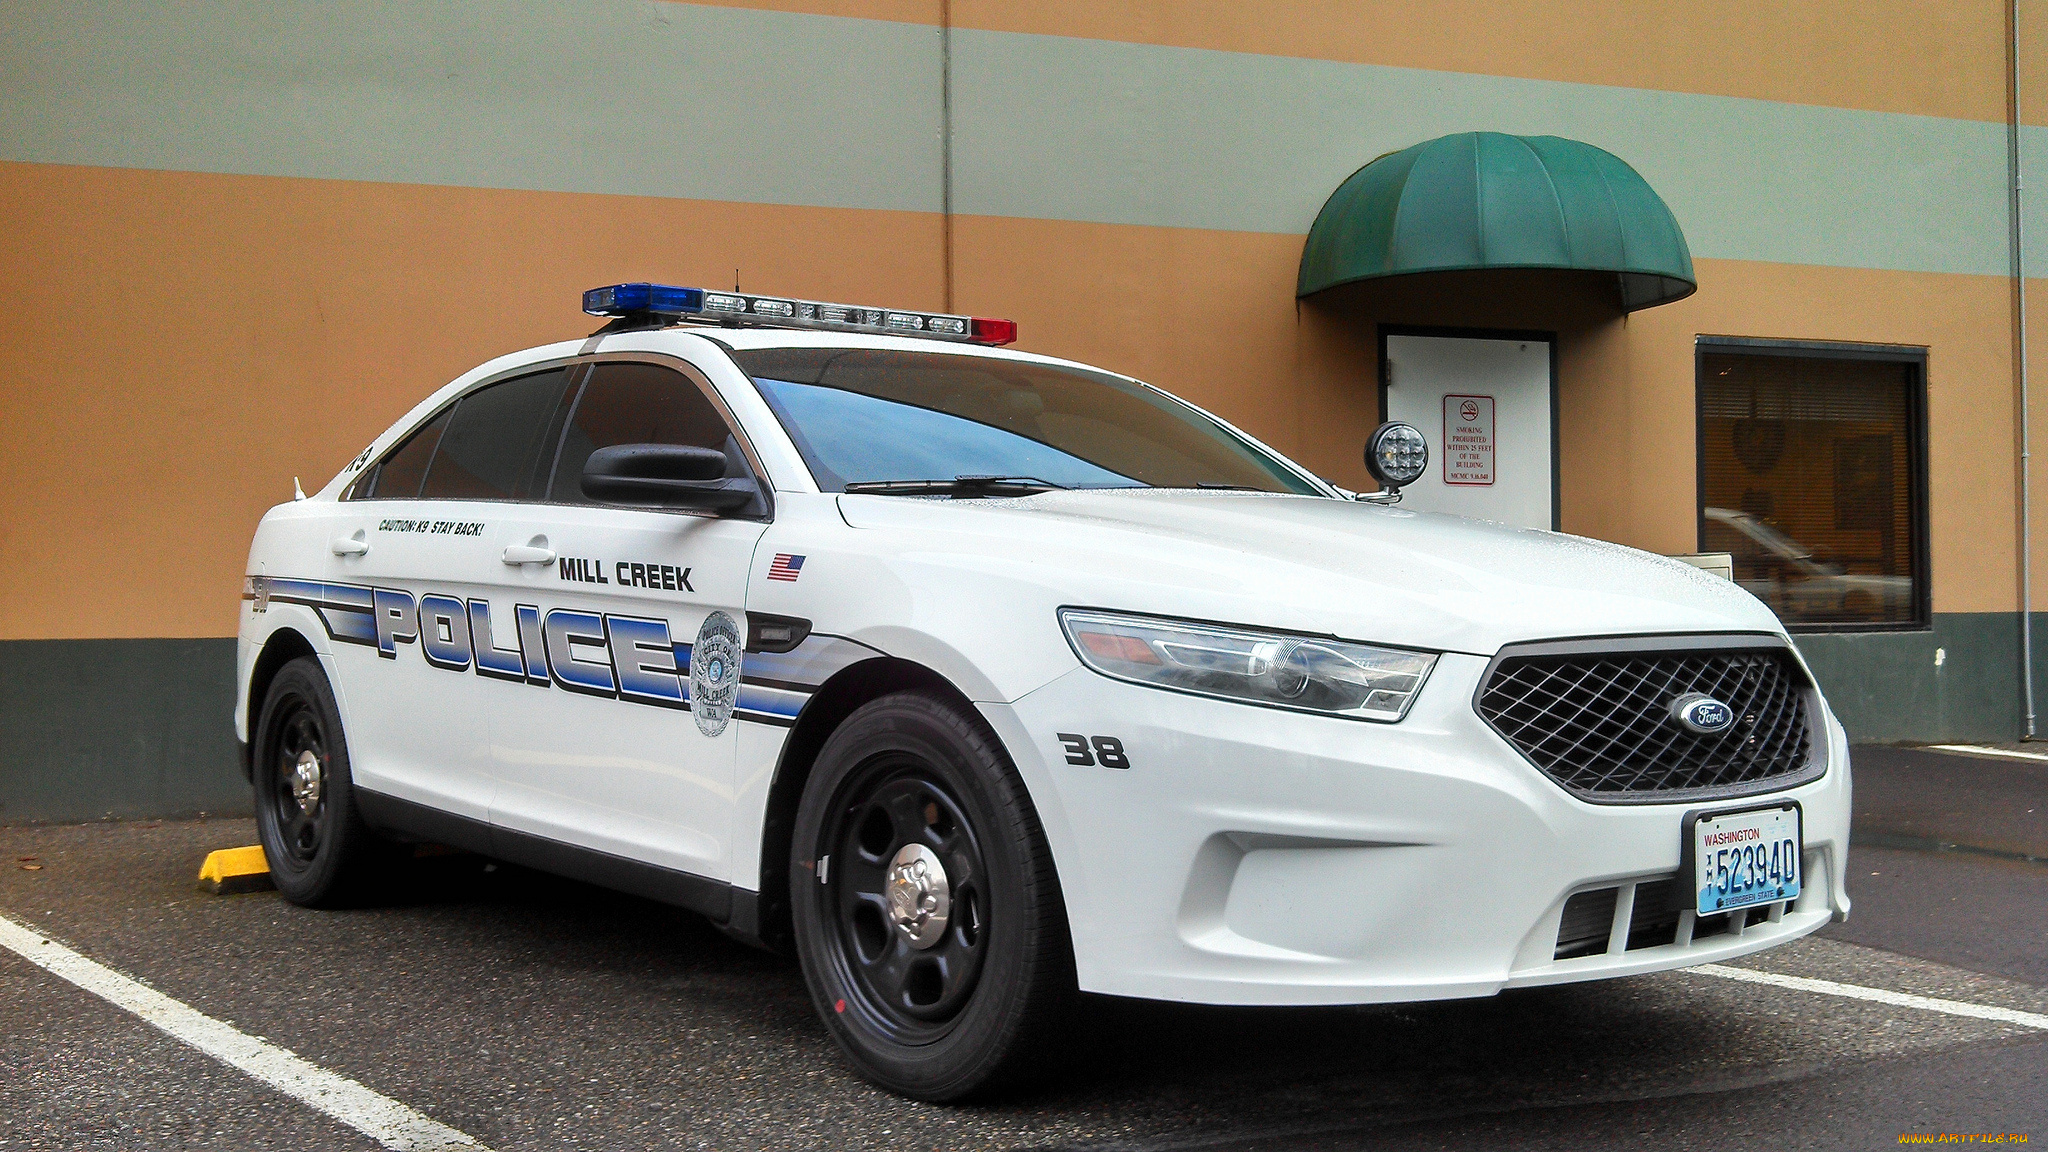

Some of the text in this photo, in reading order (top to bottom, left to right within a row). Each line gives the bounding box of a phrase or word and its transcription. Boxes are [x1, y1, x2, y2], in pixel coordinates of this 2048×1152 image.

[378, 519, 485, 537] CAUTION: K9 STAY BACK!
[558, 557, 695, 593] MILL CREEK
[371, 586, 684, 703] POLICE
[706, 707, 717, 718] WA
[1698, 705, 1724, 725] Ford
[1055, 732, 1132, 770] 38
[1704, 828, 1760, 847] WASHINGTON
[1725, 889, 1775, 907] EVERGREEN STATE
